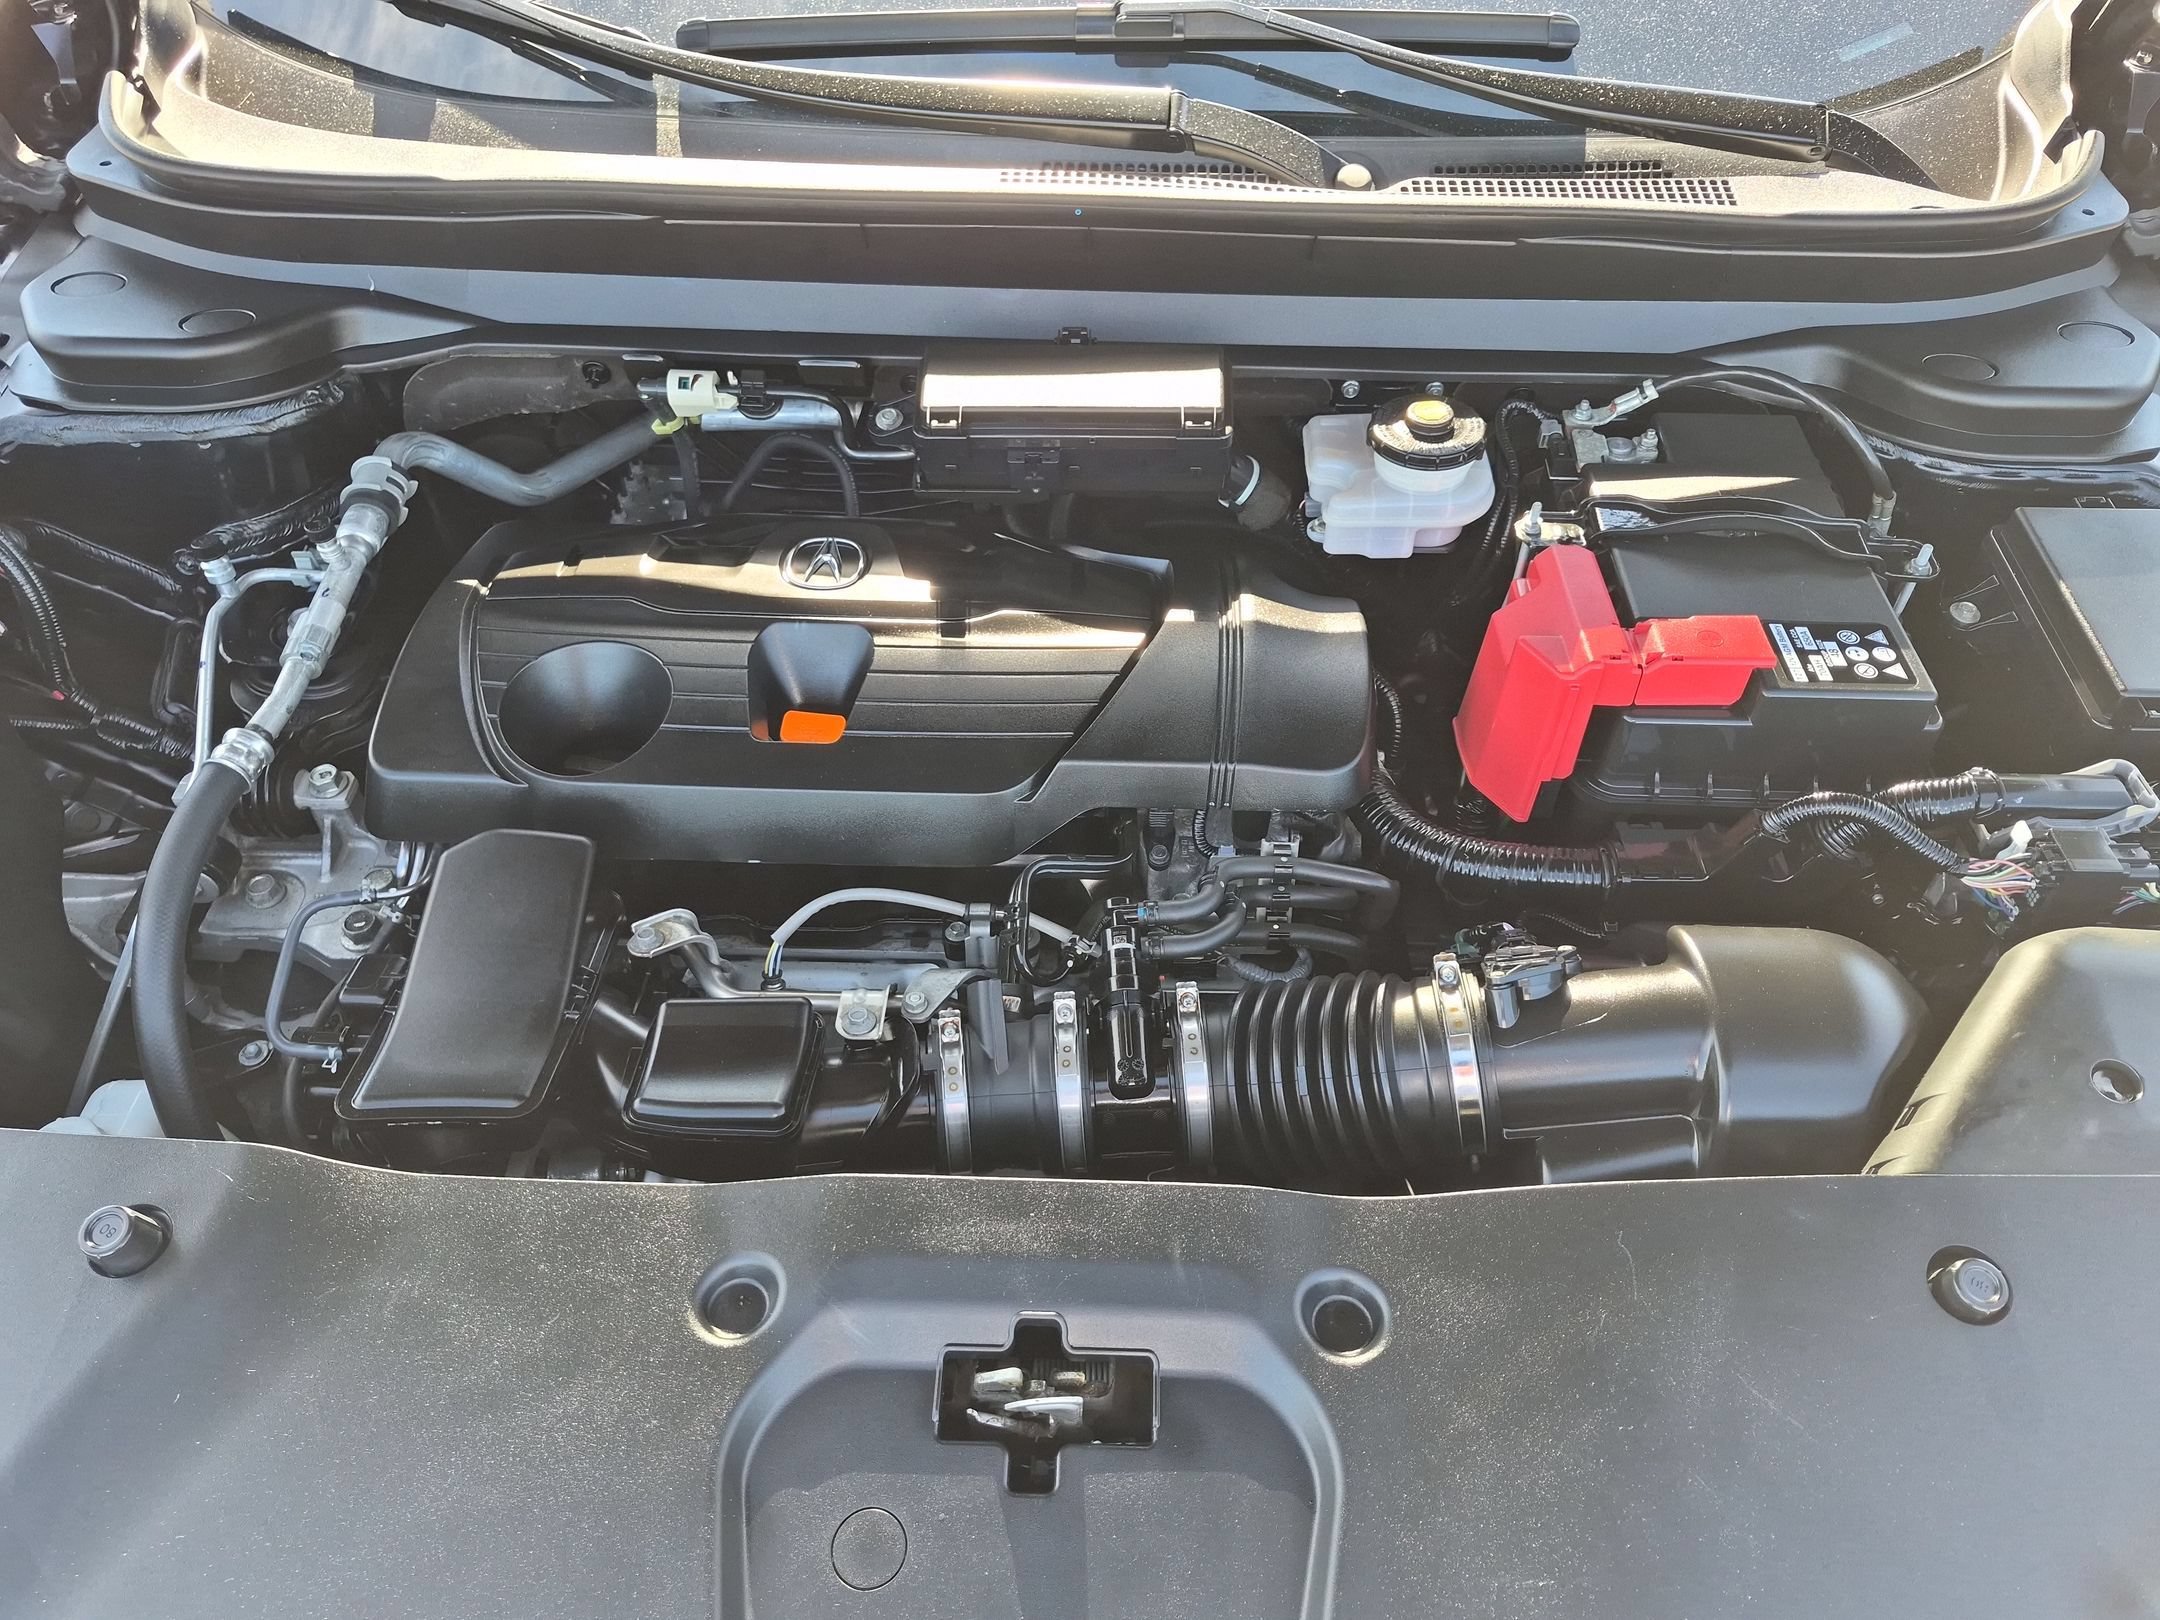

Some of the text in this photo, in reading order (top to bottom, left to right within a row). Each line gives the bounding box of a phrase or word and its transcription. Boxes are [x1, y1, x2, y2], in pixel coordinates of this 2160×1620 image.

[1775, 625, 1787, 643] Battery
[1789, 629, 1798, 639] CCA
[1780, 643, 1792, 656] AGM
